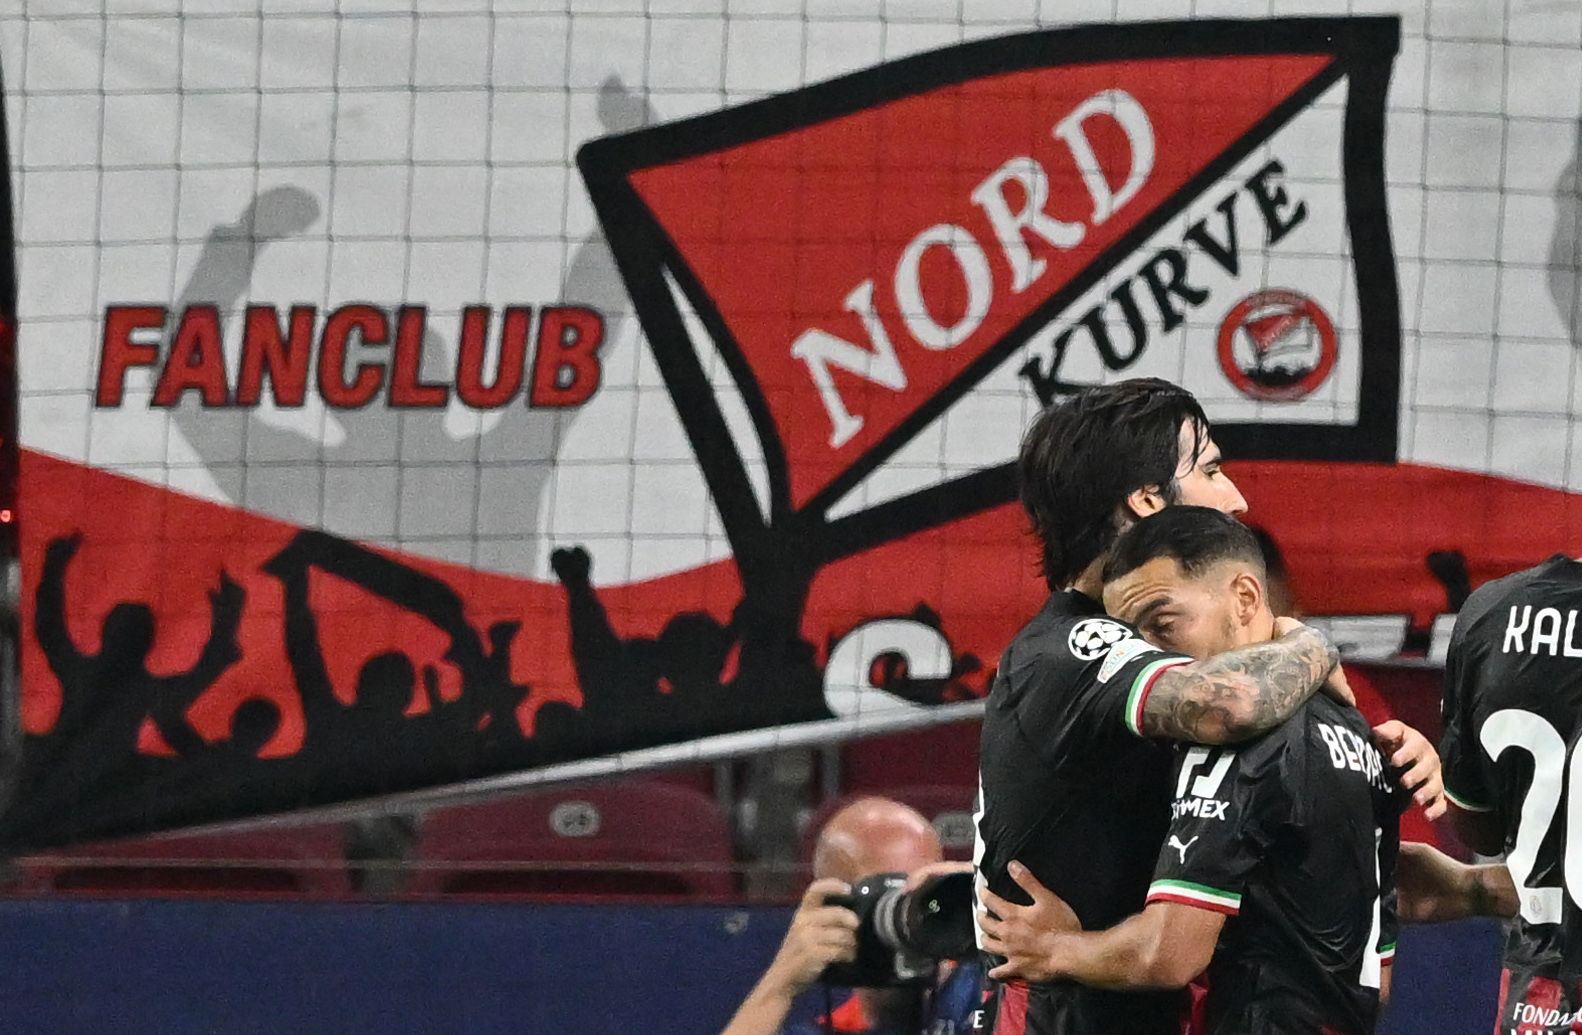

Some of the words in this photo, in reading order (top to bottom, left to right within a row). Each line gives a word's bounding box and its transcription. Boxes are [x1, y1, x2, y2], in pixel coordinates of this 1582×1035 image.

[94, 301, 606, 410] FANCLUB
[791, 88, 1156, 449] NORD
[1018, 159, 1309, 411] KURVE
